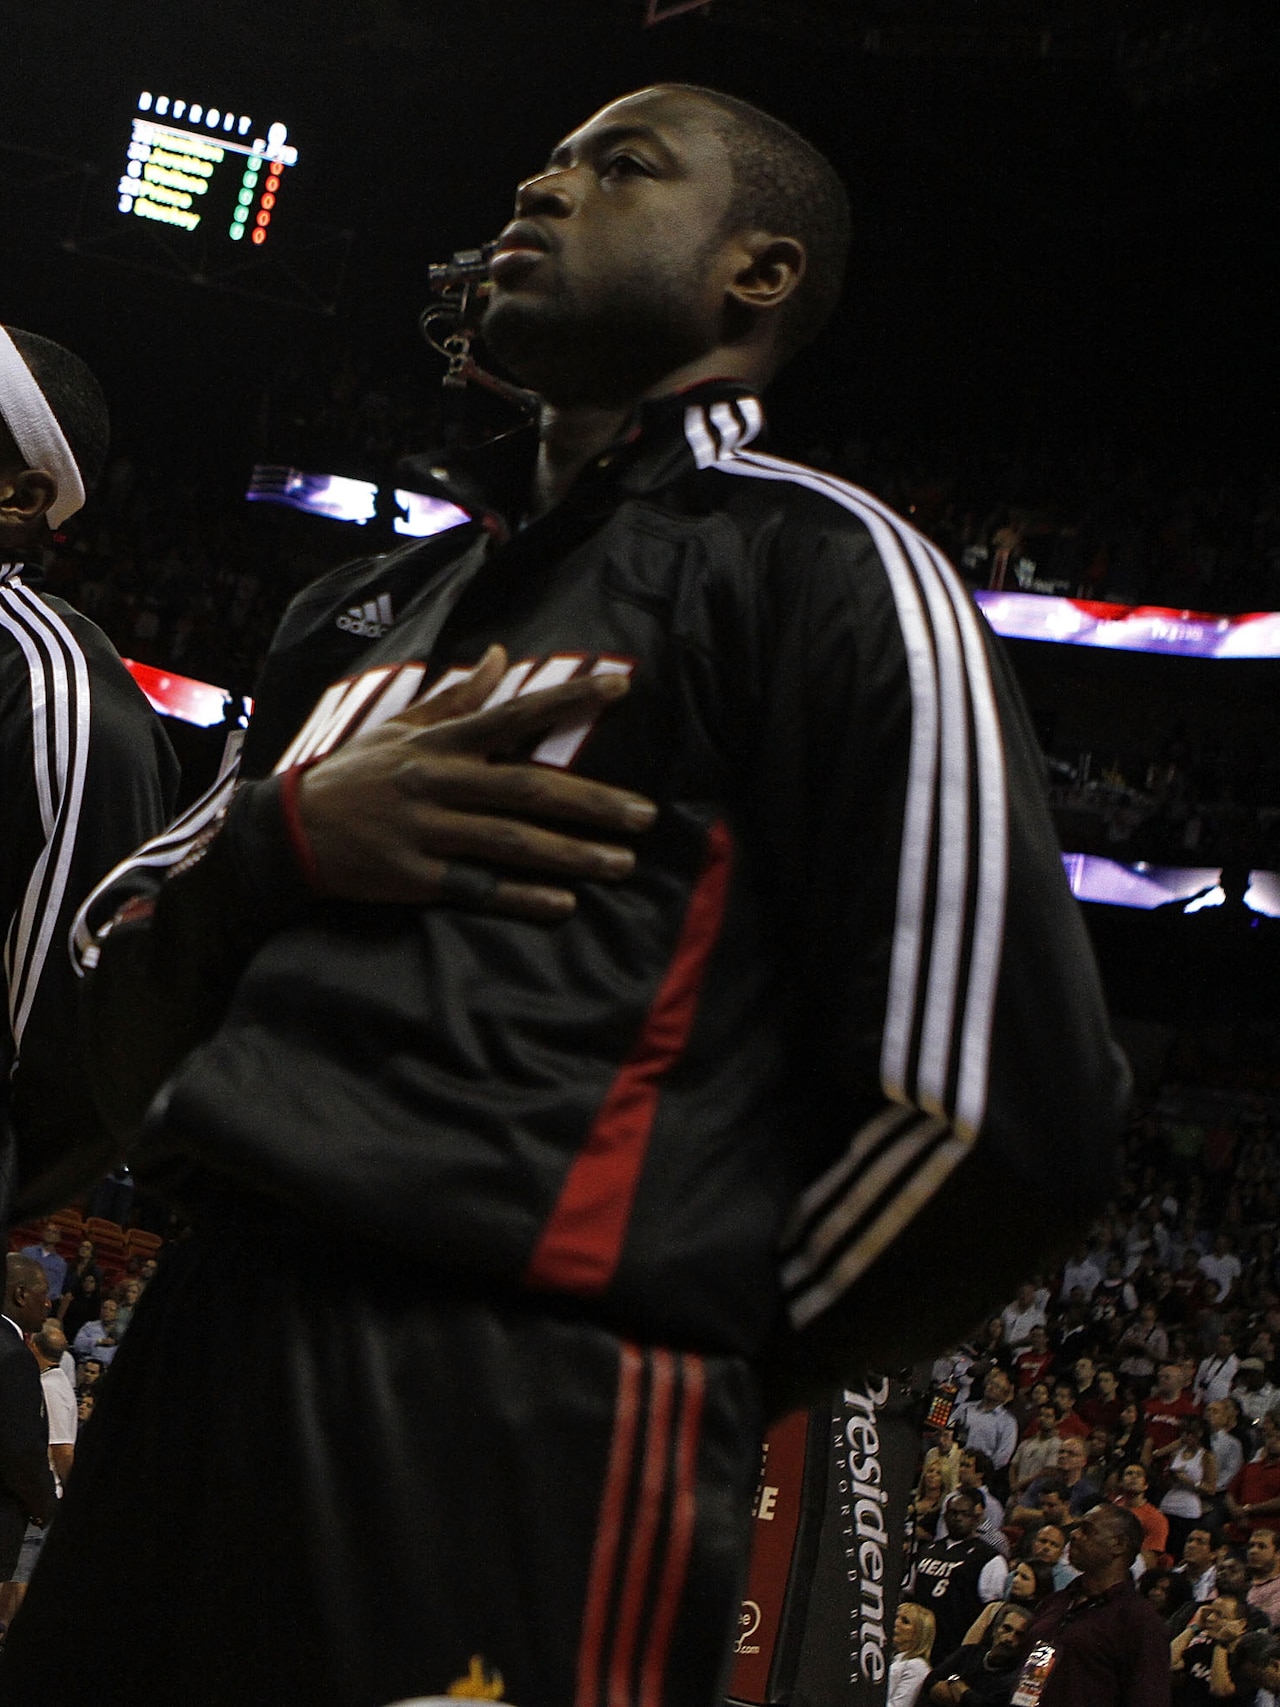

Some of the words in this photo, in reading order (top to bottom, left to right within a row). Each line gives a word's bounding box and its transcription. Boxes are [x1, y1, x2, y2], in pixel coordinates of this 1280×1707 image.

[844, 1375, 890, 1685] Presidente
[918, 1557, 966, 1578] HEAT
[931, 1578, 951, 1598] 6
